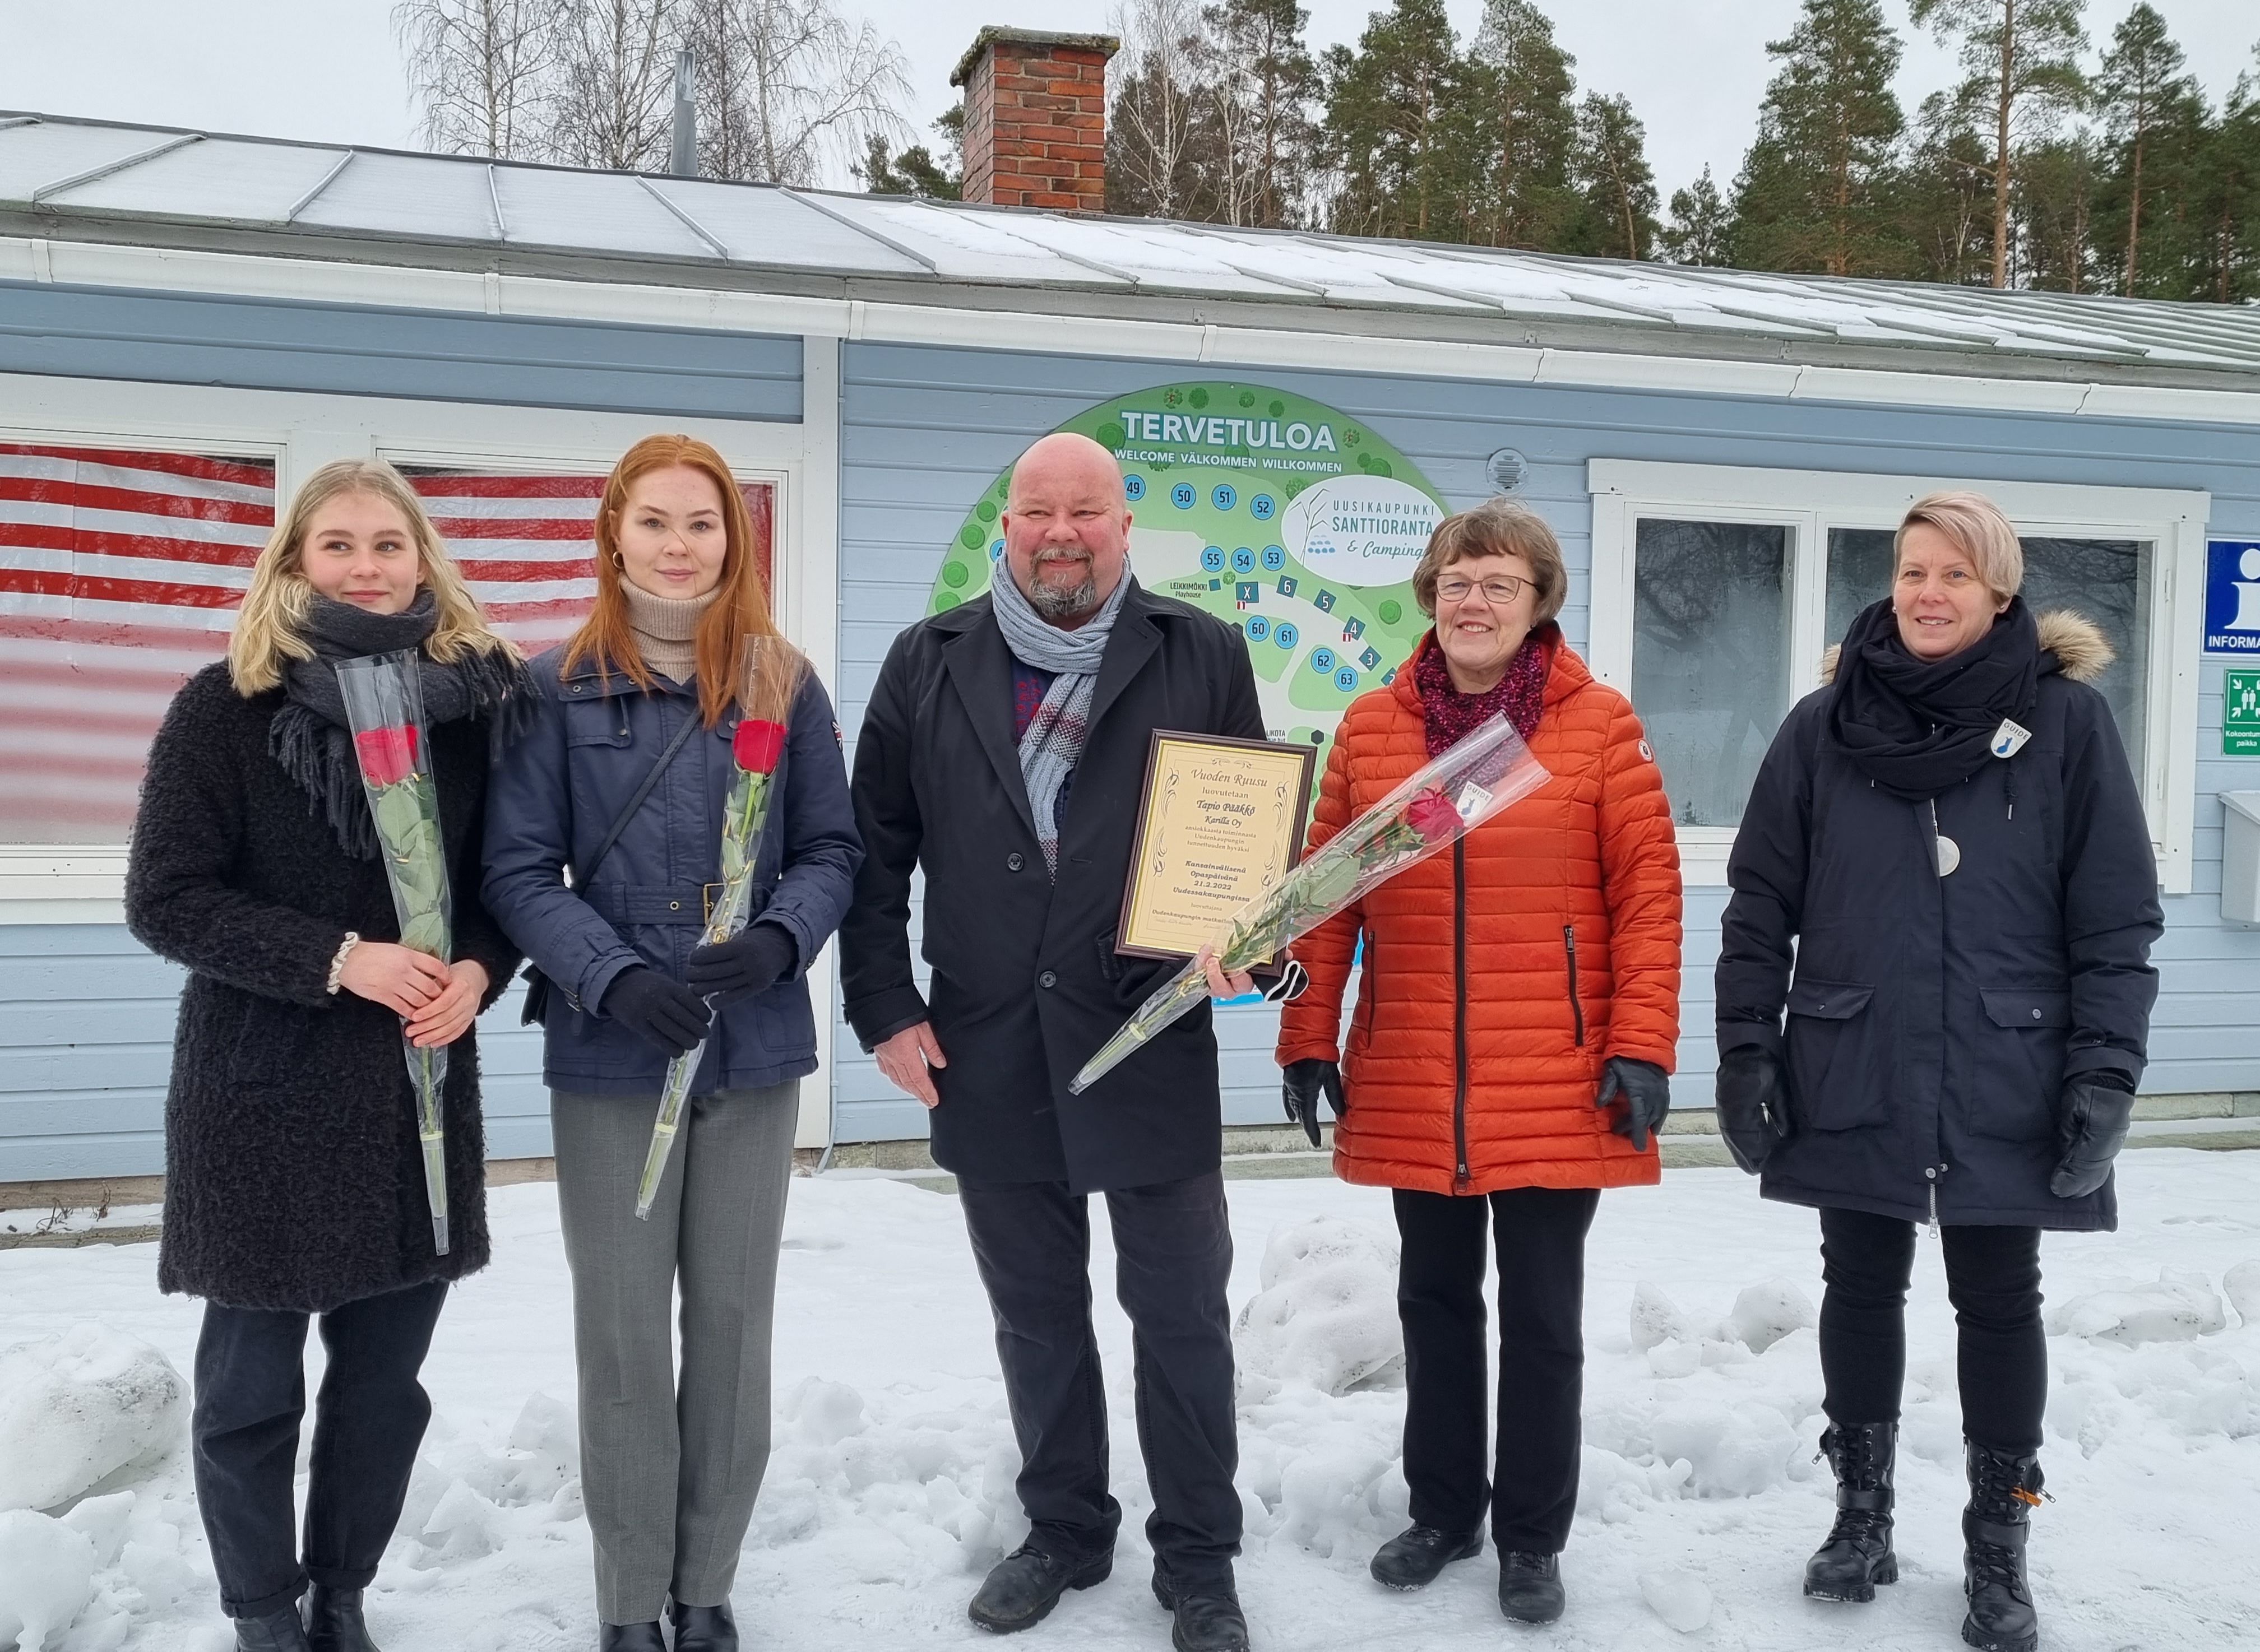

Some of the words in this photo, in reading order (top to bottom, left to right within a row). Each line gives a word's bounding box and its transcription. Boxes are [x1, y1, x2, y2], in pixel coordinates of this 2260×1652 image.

[1121, 411, 1336, 452] TERVETULOA
[1114, 449, 1175, 462] WELCOME
[1180, 451, 1257, 468] VÄLKOMMEN
[1262, 458, 1342, 472] WILLKOMMEN
[1127, 482, 1140, 494] 49
[1178, 490, 1191, 502] 50
[1219, 491, 1230, 503] 51
[1257, 501, 1269, 513] 52
[1333, 500, 1434, 516] UUSIKAUPUNKI
[1332, 516, 1433, 536] SANTTIORANTA
[1347, 540, 1358, 552] &
[1363, 541, 1425, 560] Camping
[1207, 553, 1219, 565] 55
[1237, 555, 1249, 567] 54
[1268, 553, 1279, 564] 53
[1170, 582, 1207, 591] LEIKKIMÖKKI
[1284, 580, 1291, 593] 6
[1244, 586, 1251, 600] X
[1322, 596, 1329, 609] 5
[1252, 623, 1264, 634] 60
[1350, 622, 1358, 635] 4
[1281, 630, 1291, 642] 61
[1317, 655, 1329, 667] 62
[1367, 653, 1373, 666] 3
[1341, 674, 1353, 685] 63
[2004, 722, 2029, 740] GUIDE
[1191, 768, 1230, 782] Vuoden
[1234, 774, 1267, 787] Ruusu
[1202, 787, 1248, 799] luovutetaan
[1197, 800, 1220, 812] Tapio
[1222, 803, 1256, 816] Pääkkö
[1205, 815, 1229, 824] Karilla
[1231, 819, 1242, 828] Oy
[1194, 833, 1244, 844] Uudenkaupungin
[1185, 860, 1246, 873] Kansainvälisenä
[1191, 870, 1238, 881] Opaspäivänä
[1194, 880, 1231, 890] 21.2.2022
[1173, 887, 1250, 902] Uudessakaupungissa
